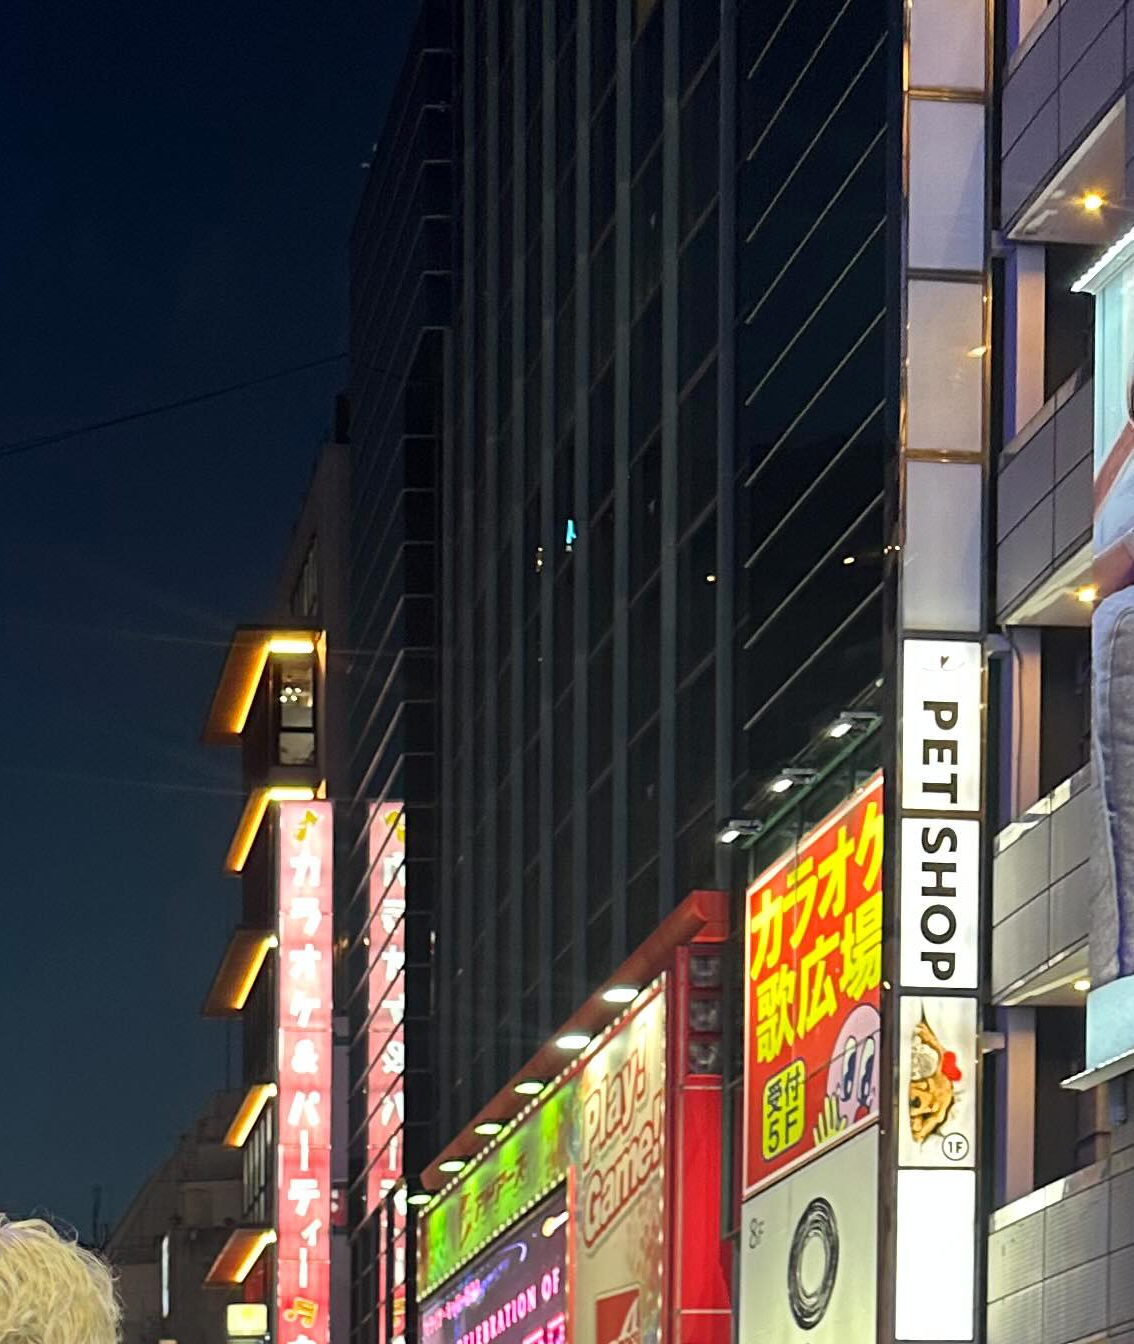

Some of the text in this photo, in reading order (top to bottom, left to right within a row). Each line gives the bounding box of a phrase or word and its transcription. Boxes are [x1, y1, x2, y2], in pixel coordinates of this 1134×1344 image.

[751, 800, 883, 982] カラオケ
[920, 701, 959, 982] PET SHOP
[755, 890, 883, 1065] 歌広場
[583, 1023, 646, 1171] Play!
[767, 1065, 801, 1119] 受付
[768, 1105, 799, 1153] 5F
[948, 1140, 963, 1154] 1F
[583, 1088, 663, 1249] Game!
[541, 1267, 561, 1302] OF
